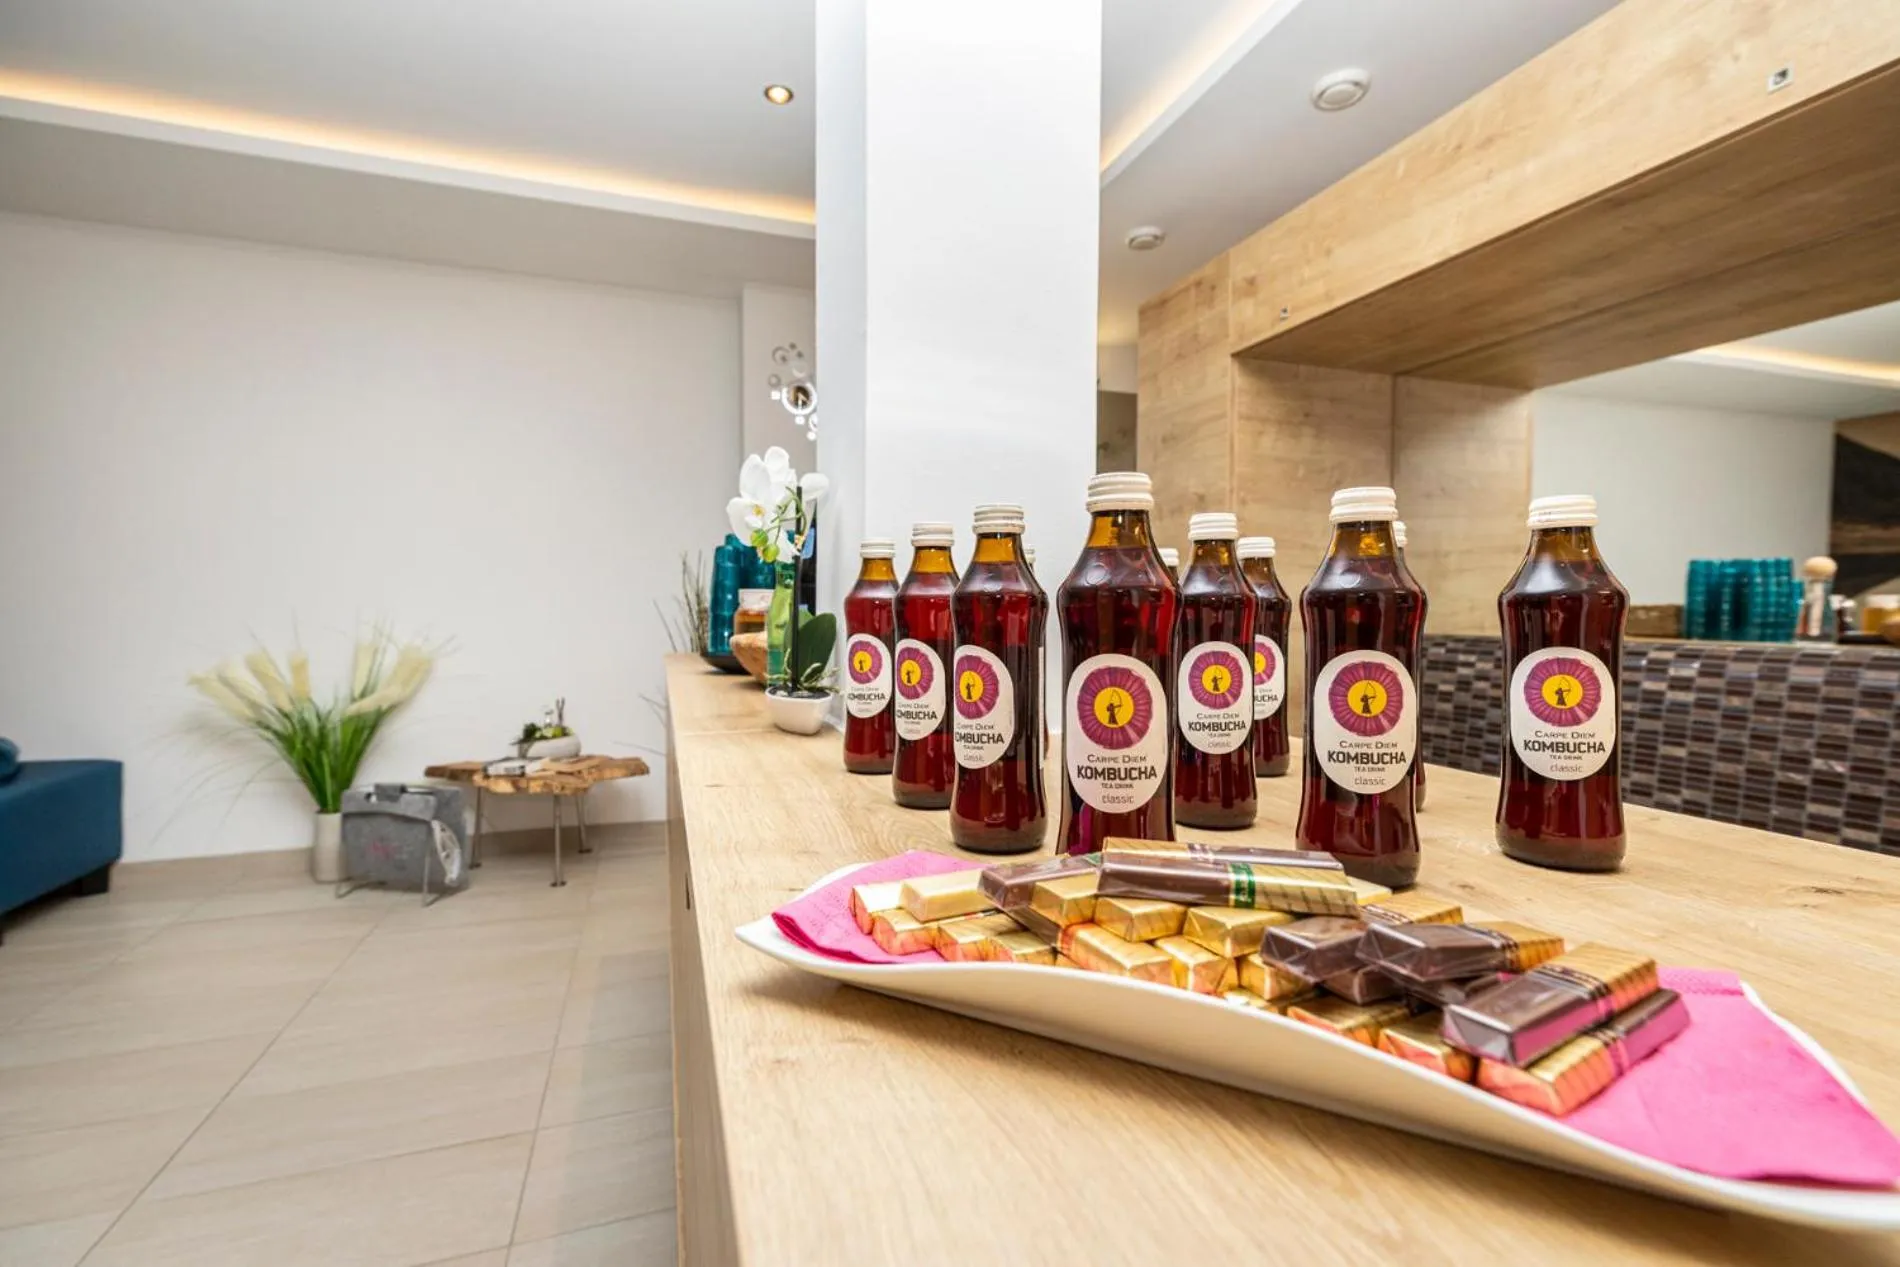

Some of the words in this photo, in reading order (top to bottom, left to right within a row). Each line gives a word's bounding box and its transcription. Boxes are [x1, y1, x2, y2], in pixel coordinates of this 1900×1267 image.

[1187, 720, 1247, 732] KOMBUCHA
[954, 731, 1005, 745] OMBUCHA
[1523, 739, 1607, 754] KOMBUCHA
[1327, 749, 1407, 765] KOMBUCHA
[1077, 765, 1158, 781] KOMBUCHA
[1550, 763, 1583, 773] classic
[1354, 775, 1386, 786] classic
[1101, 793, 1135, 804] classic
